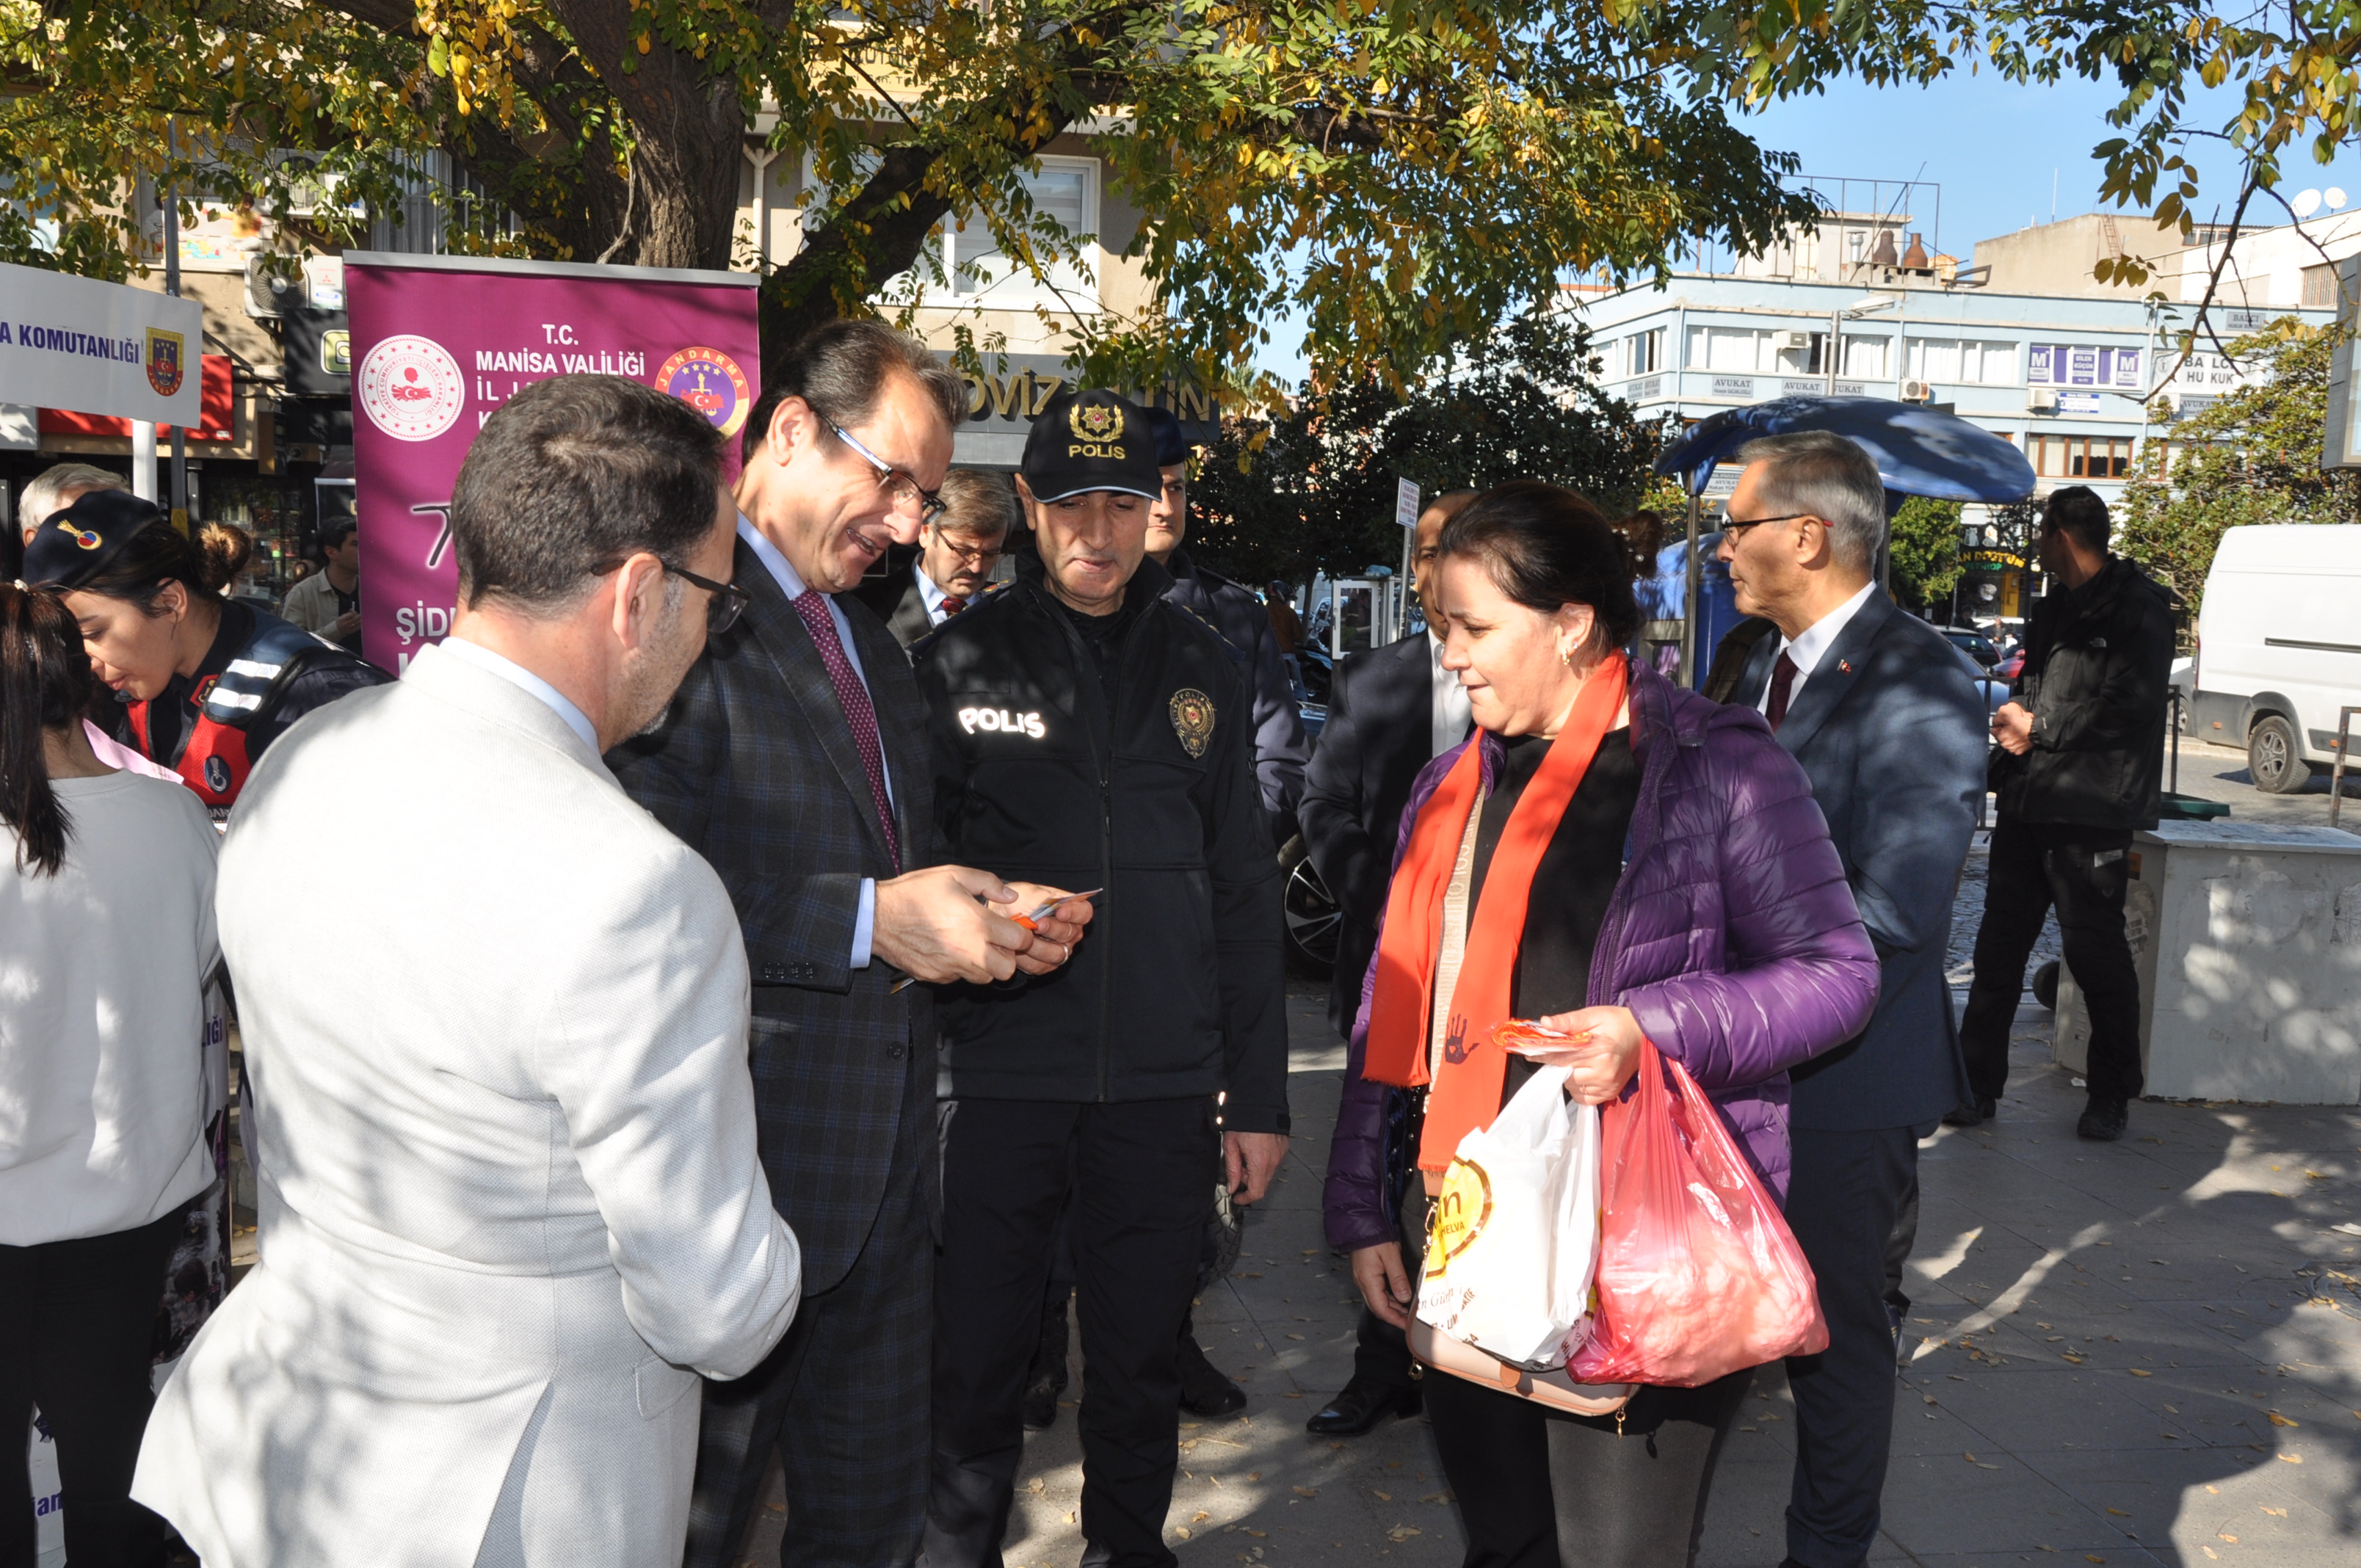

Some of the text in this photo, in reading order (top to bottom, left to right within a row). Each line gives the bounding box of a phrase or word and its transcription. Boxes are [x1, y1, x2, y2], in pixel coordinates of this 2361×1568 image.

[19, 324, 139, 365] KOMUTANLIĞI
[542, 324, 579, 346] T.C.
[476, 347, 645, 377] MANİSA VALİLİĞİ
[659, 349, 744, 388] JANDARMA
[477, 376, 499, 401] İL
[1715, 379, 1752, 388] AVUKAT
[1784, 382, 1821, 391] AVUKAT
[1834, 385, 1863, 393] VUKAT
[2183, 400, 2211, 408] AVUKA
